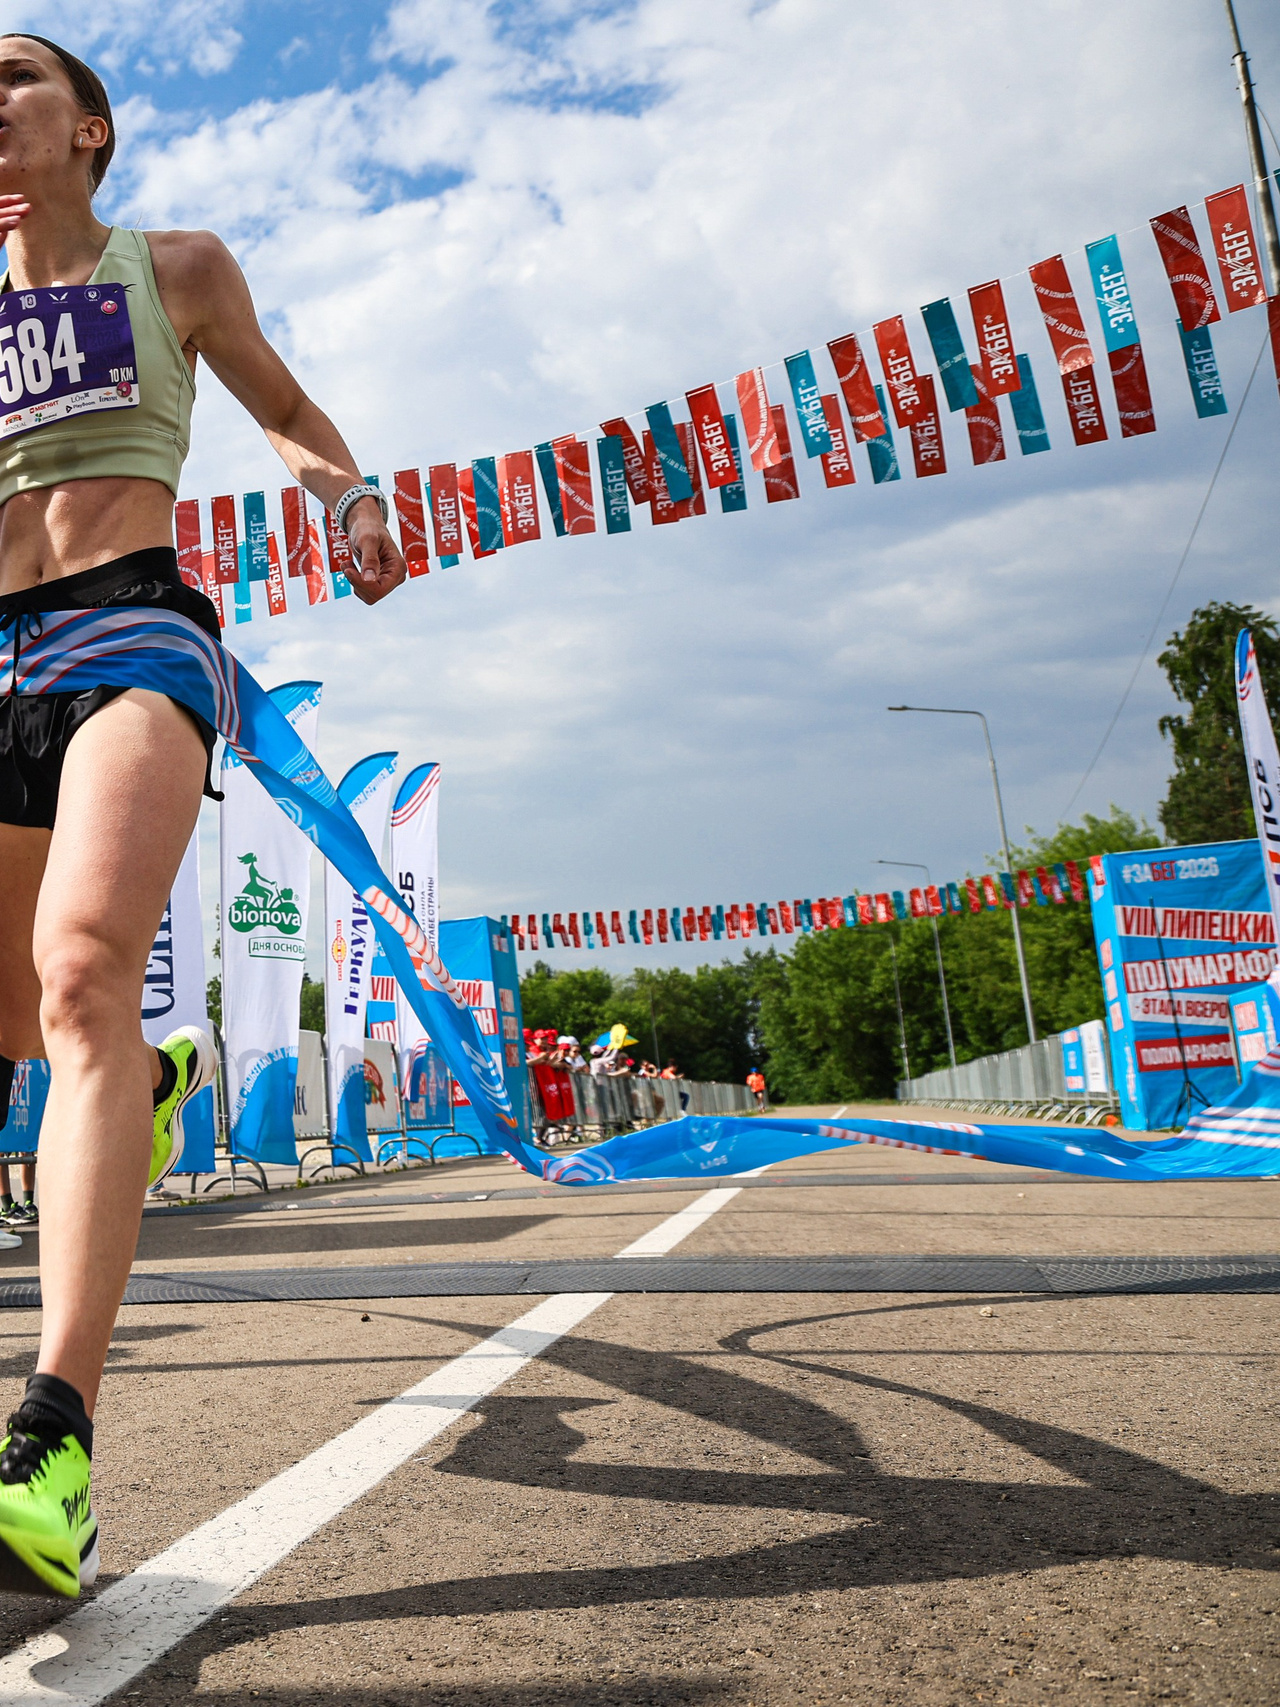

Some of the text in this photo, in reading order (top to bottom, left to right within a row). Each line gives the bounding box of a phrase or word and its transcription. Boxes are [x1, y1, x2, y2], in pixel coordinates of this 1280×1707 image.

[109, 369, 119, 383] 10
[230, 903, 302, 927] bionova
[252, 940, 270, 951] ДНЯ
